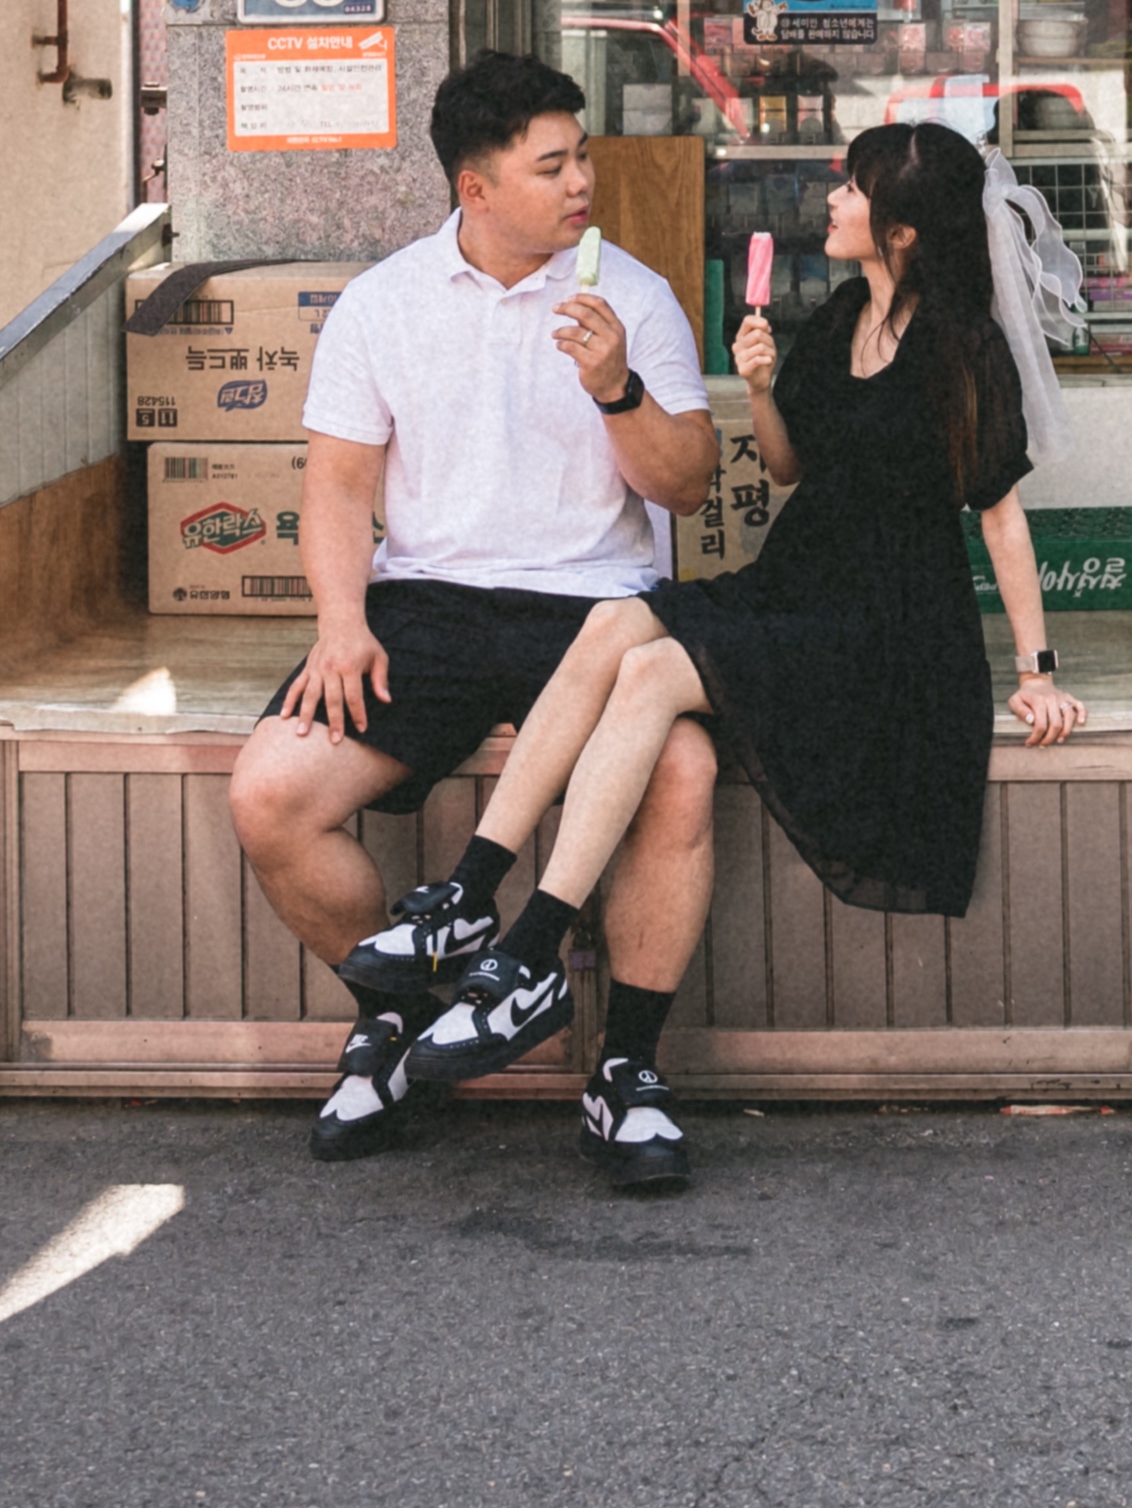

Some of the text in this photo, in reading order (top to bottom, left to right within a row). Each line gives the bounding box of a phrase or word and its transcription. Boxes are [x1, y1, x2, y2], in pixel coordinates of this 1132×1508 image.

[267, 35, 353, 50] CCTV 설치안내
[185, 346, 300, 372] 녹차 뽀드득
[137, 395, 176, 407] 115428
[217, 383, 266, 407] 참그린
[141, 414, 150, 425] 5
[182, 508, 263, 549] 유한락스
